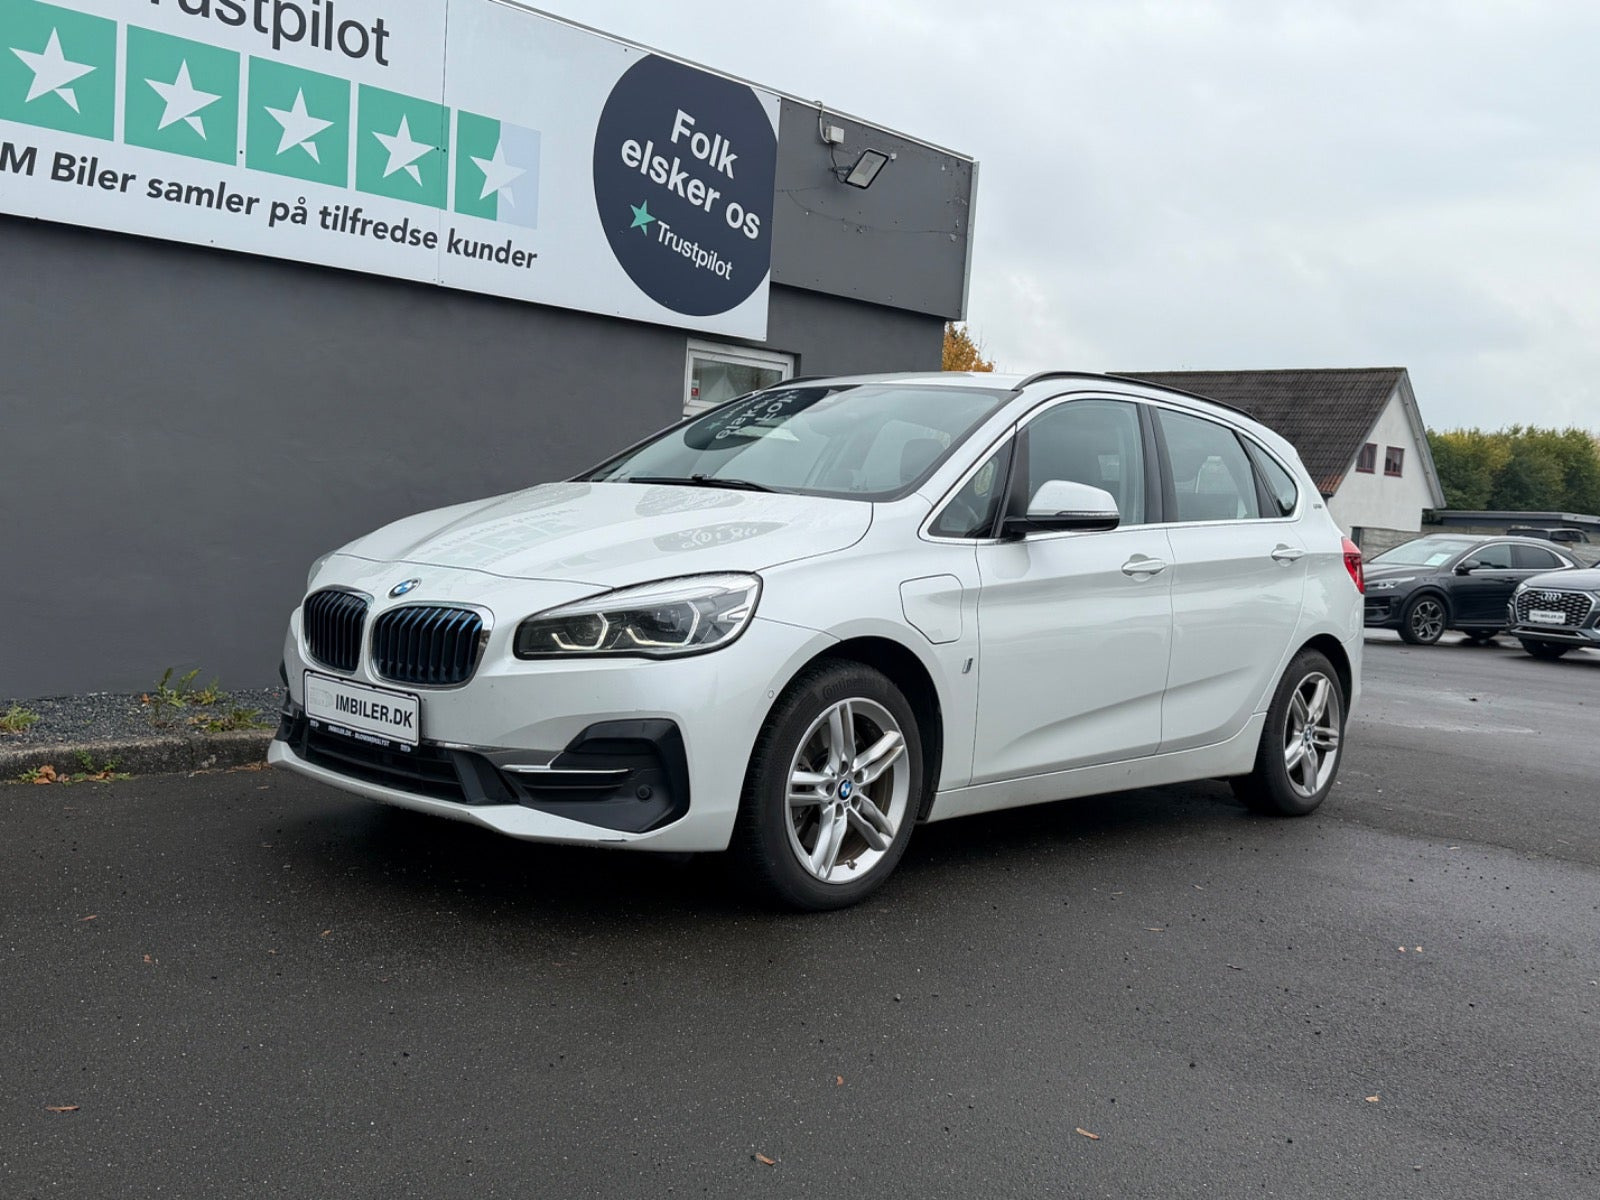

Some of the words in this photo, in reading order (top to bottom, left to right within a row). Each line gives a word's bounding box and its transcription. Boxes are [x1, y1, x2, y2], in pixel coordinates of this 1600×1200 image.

[670, 108, 739, 180] Folk
[51, 151, 137, 193] Biler
[146, 178, 260, 215] samler
[268, 196, 308, 228] på
[319, 204, 438, 250] tilfredse
[446, 228, 538, 269] kunder
[621, 139, 721, 213] elsker
[725, 202, 761, 240] os
[657, 220, 733, 281] Trustpilot
[335, 693, 414, 729] IMBILER.DK
